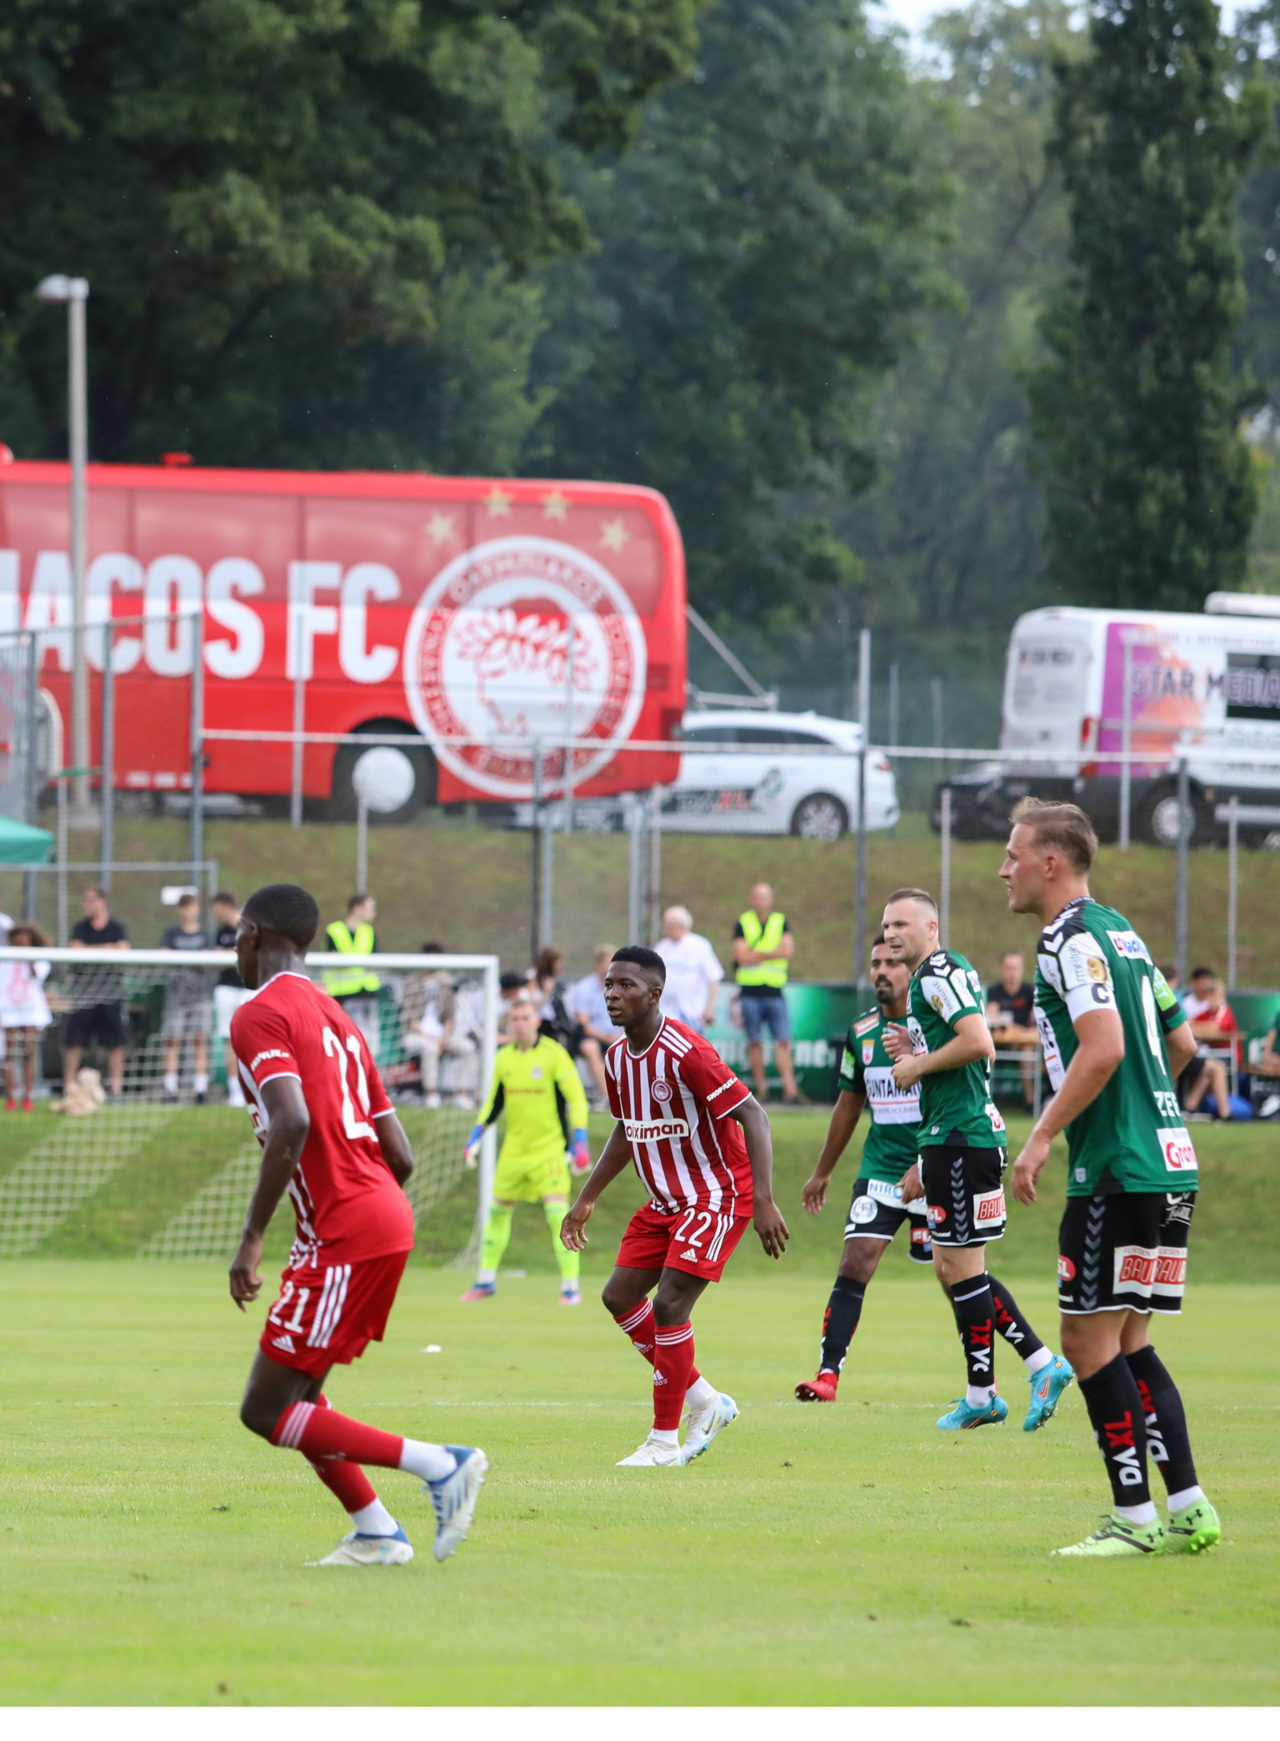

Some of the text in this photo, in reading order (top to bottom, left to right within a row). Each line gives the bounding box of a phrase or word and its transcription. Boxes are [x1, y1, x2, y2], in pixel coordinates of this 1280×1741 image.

[286, 561, 401, 683] FC
[1091, 983, 1110, 1004] C
[322, 1026, 379, 1143] 21
[675, 1207, 712, 1248] 22
[268, 1280, 311, 1334] 21
[1103, 1410, 1144, 1487] DAXL
